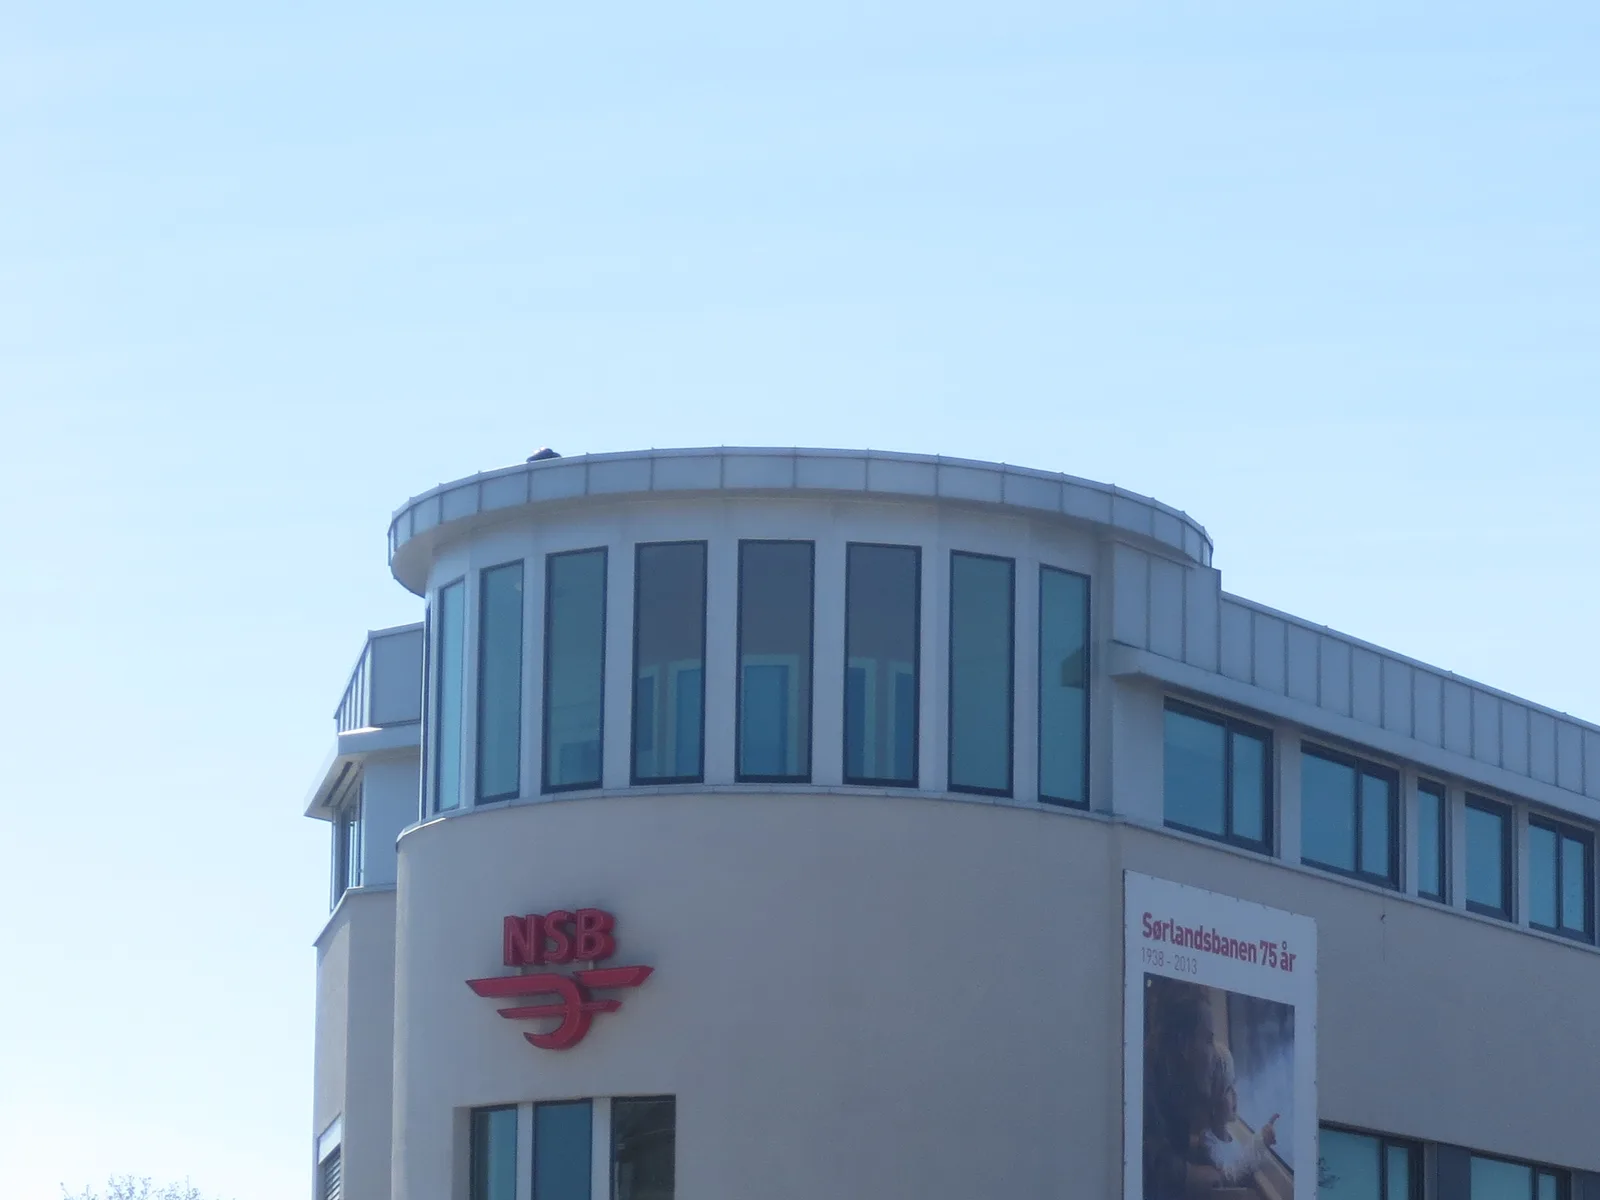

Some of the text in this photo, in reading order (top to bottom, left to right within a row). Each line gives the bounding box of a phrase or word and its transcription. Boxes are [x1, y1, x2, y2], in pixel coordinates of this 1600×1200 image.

[504, 908, 616, 967] NSB
[1141, 947, 1164, 967] 1938
[1174, 954, 1198, 975] 2013
[1142, 911, 1297, 972] Sørlandsbanen 75 år
